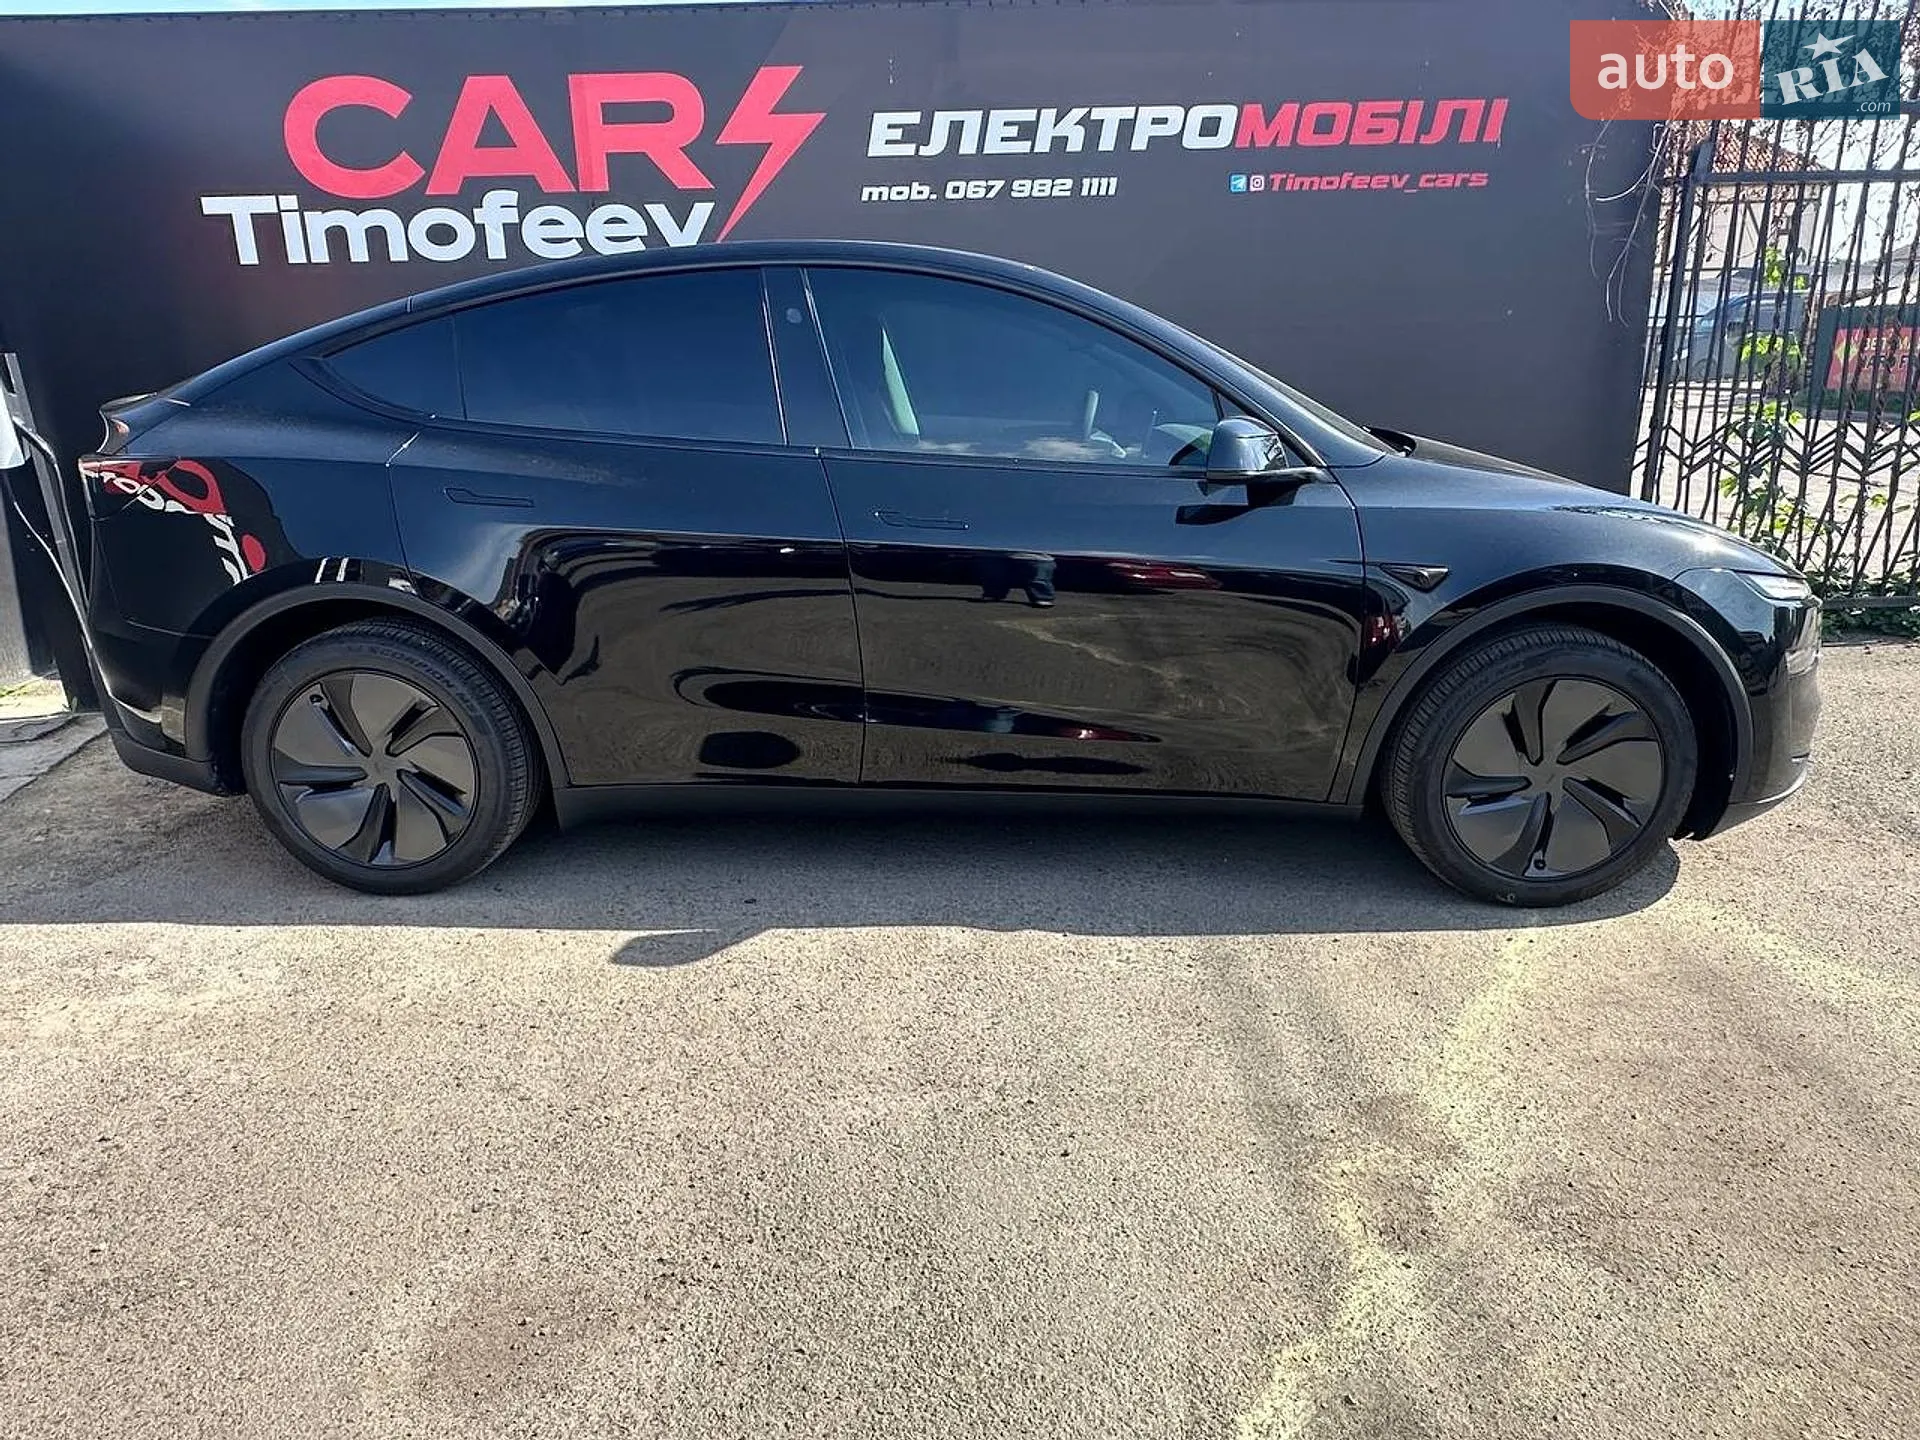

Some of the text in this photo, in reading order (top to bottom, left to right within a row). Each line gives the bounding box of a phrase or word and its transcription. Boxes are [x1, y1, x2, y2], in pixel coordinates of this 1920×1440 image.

[861, 176, 1118, 201] mob. 067 982 1111
[1269, 171, 1489, 193] Timofeev_cars
[201, 190, 716, 266] Timofeev
